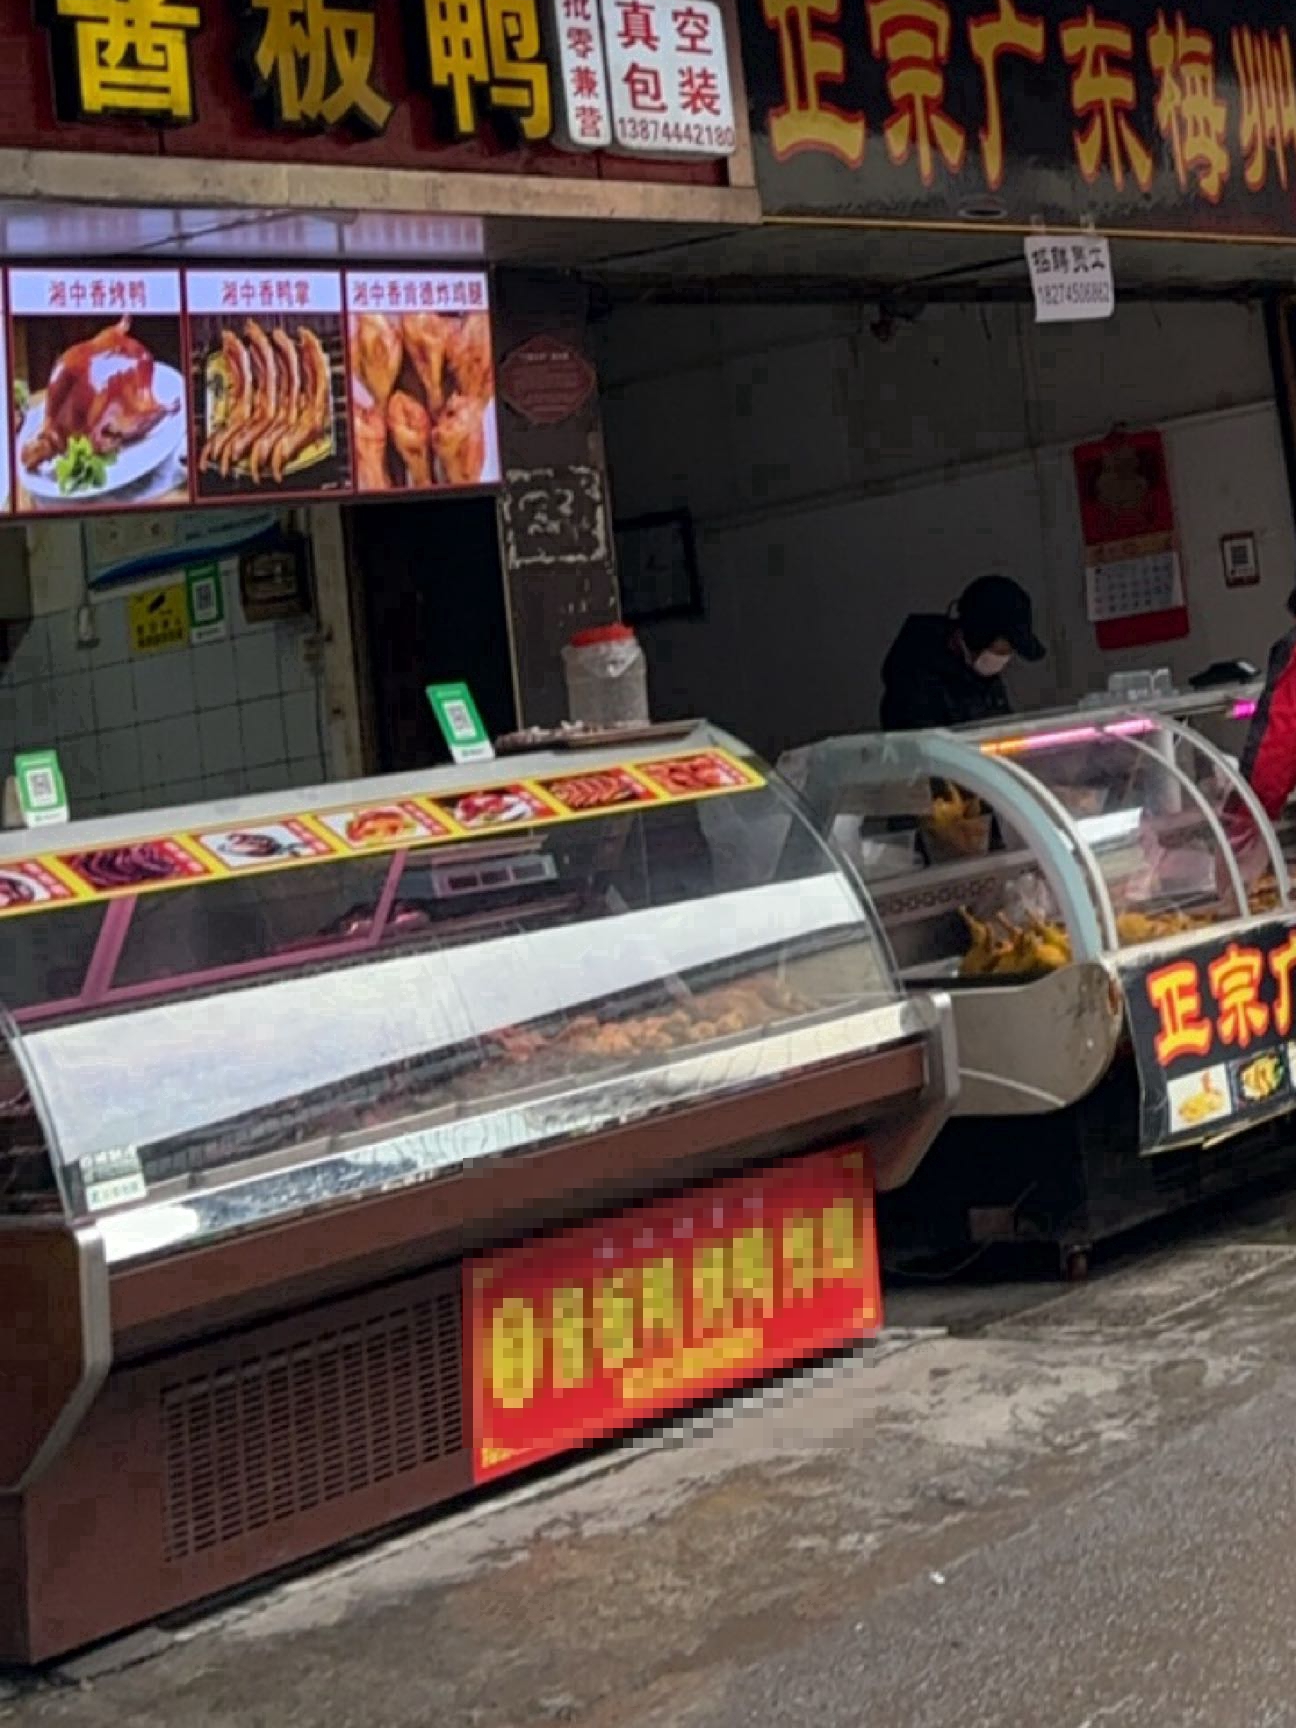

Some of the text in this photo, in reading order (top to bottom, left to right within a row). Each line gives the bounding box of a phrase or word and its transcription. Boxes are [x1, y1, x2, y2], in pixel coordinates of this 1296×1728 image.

[614, 0, 713, 57] 真空
[620, 60, 722, 117] 包装
[616, 115, 734, 148] 13874442180
